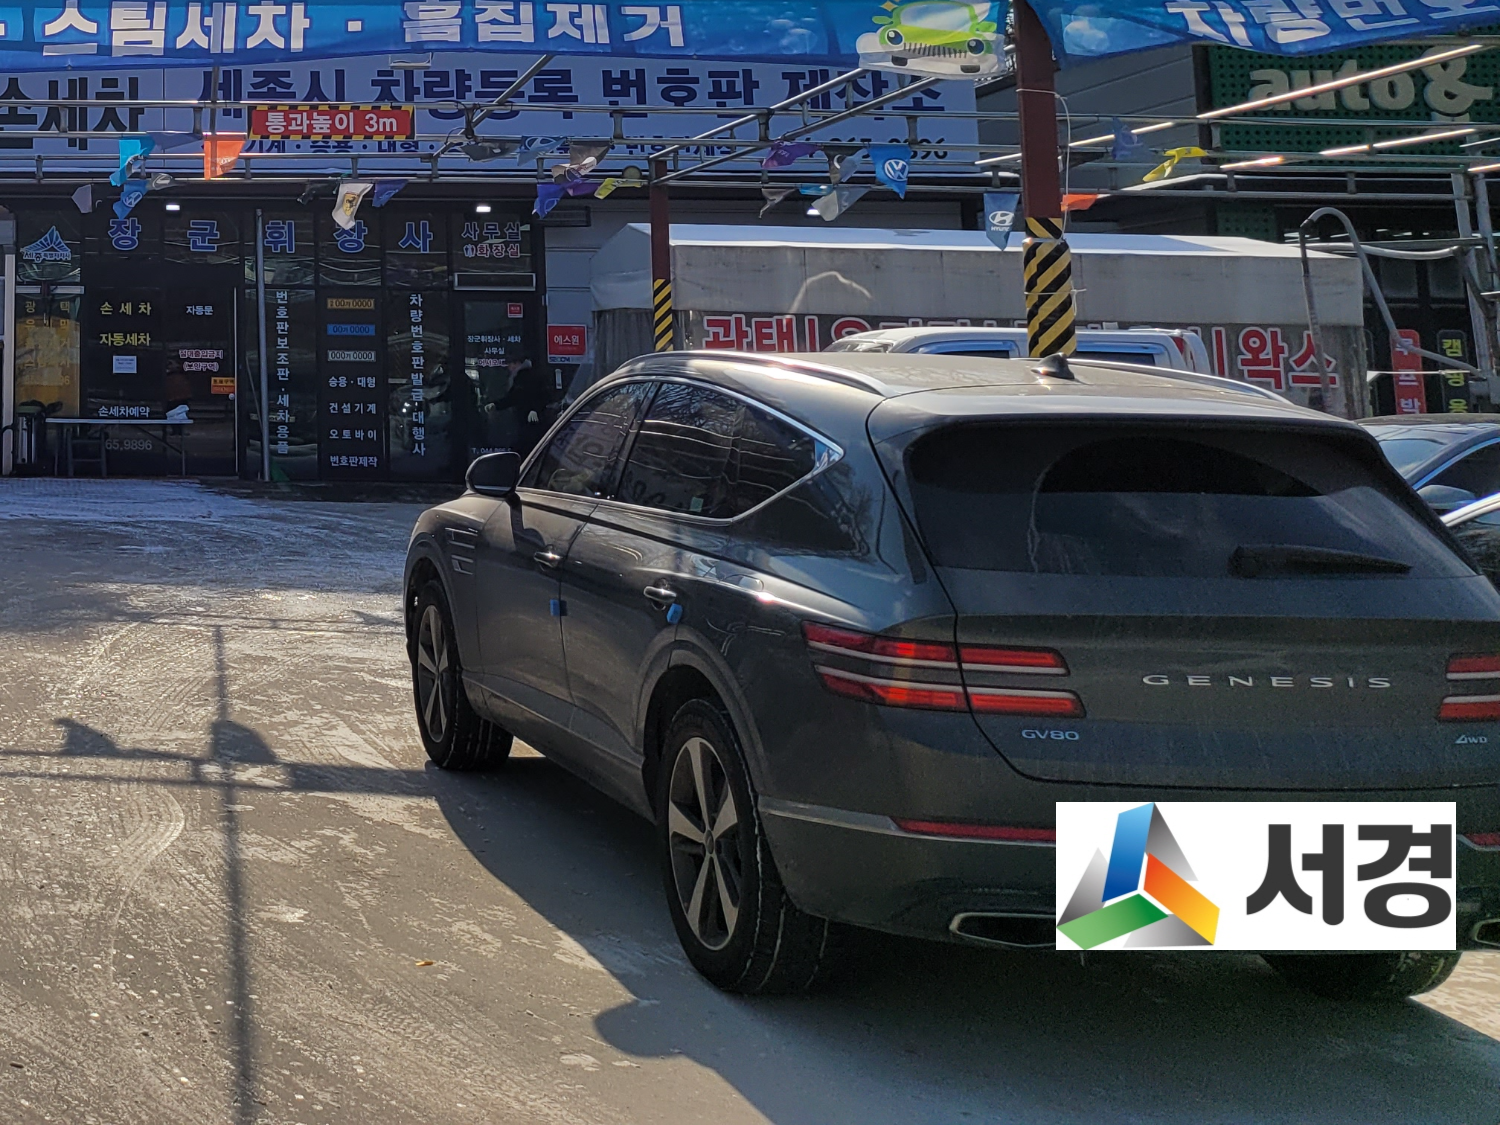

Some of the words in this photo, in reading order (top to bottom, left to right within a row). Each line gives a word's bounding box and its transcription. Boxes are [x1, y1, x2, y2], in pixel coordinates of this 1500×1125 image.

[42, 0, 311, 57] 스팀세차
[602, 68, 760, 119] 번호판
[265, 111, 354, 134] 통과높이
[364, 111, 398, 133] 3m
[462, 222, 522, 241] 사무실
[478, 244, 521, 258] 화장실
[100, 302, 152, 316] 손세차
[185, 305, 214, 316] 자동문
[99, 333, 151, 347] 자동세차
[276, 291, 290, 381] 번호판보조판
[553, 335, 580, 346] 에스원
[484, 347, 505, 355] 사무실
[1237, 326, 1340, 390] 왁스
[329, 377, 348, 388] 승용
[357, 377, 376, 388] 대형
[98, 406, 150, 418] 손세차예약
[329, 403, 377, 415] 건설기계
[329, 429, 377, 442] 오토바이
[411, 411, 426, 456] 대행사
[329, 455, 378, 468] 번호판제작
[1142, 674, 1392, 688] GENESIS
[1021, 728, 1080, 742] GV80
